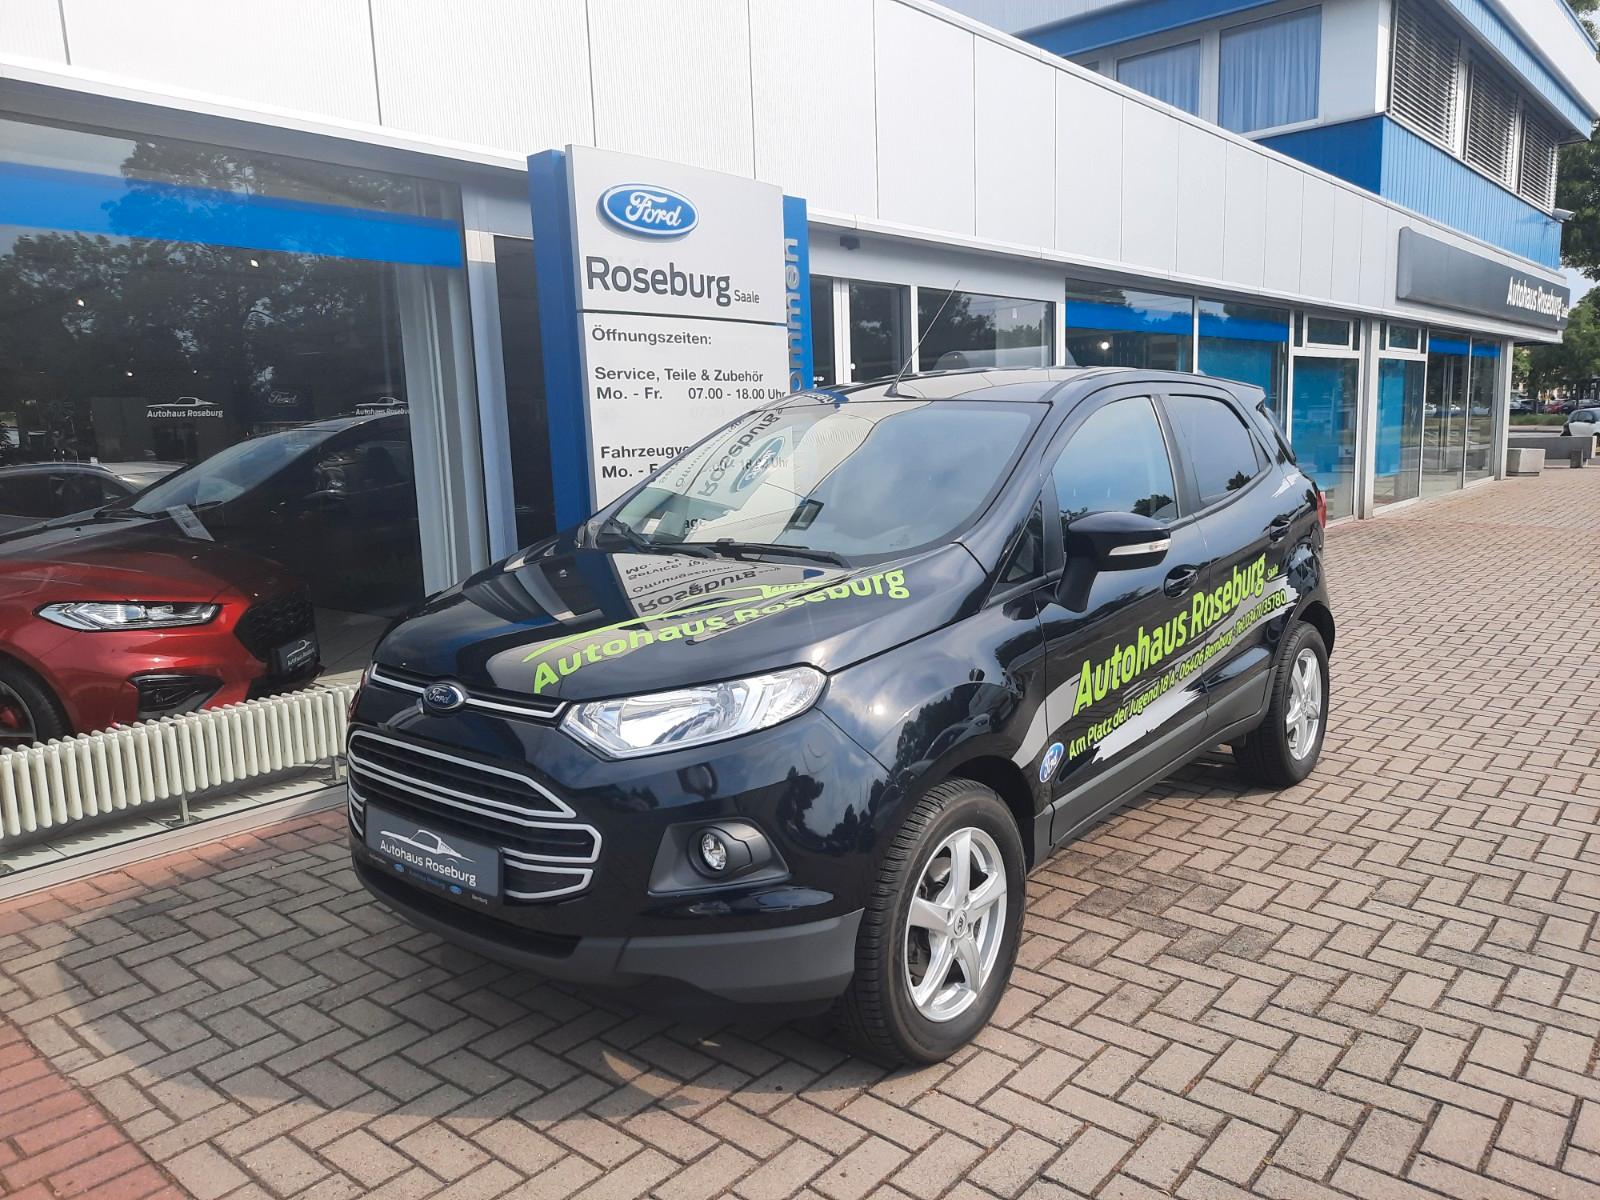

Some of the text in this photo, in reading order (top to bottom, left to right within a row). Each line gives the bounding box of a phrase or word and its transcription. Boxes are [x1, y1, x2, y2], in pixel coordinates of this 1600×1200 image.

[625, 191, 682, 226] Ford
[586, 255, 760, 307] Roseburg Saale
[1506, 276, 1537, 311] Autohaus
[1537, 286, 1562, 322] Roseburg
[592, 325, 712, 345] Öffnungszeiten:
[594, 366, 764, 382] Service, Teile & Zubehör
[596, 386, 627, 399] Mo.
[644, 387, 663, 399] Fr.
[688, 387, 723, 399] 07.00
[736, 388, 765, 399] 18.00
[768, 388, 786, 400] Uhr
[146, 409, 224, 418] Autohaus Roseburg
[602, 465, 633, 478] Mo.
[534, 569, 911, 693] Autohaus Roseburg
[1073, 611, 1187, 716] Autohaus
[1190, 552, 1266, 638] Roseburg
[429, 687, 451, 704] Ford
[1069, 736, 1086, 760] Am
[1087, 717, 1113, 747] Platz
[1113, 706, 1129, 728] der
[1128, 681, 1160, 717] Jugend
[1160, 674, 1169, 695] 18
[1204, 629, 1233, 663] Bernburg
[380, 839, 424, 867] Autohaus
[425, 857, 477, 887] Roseburg
